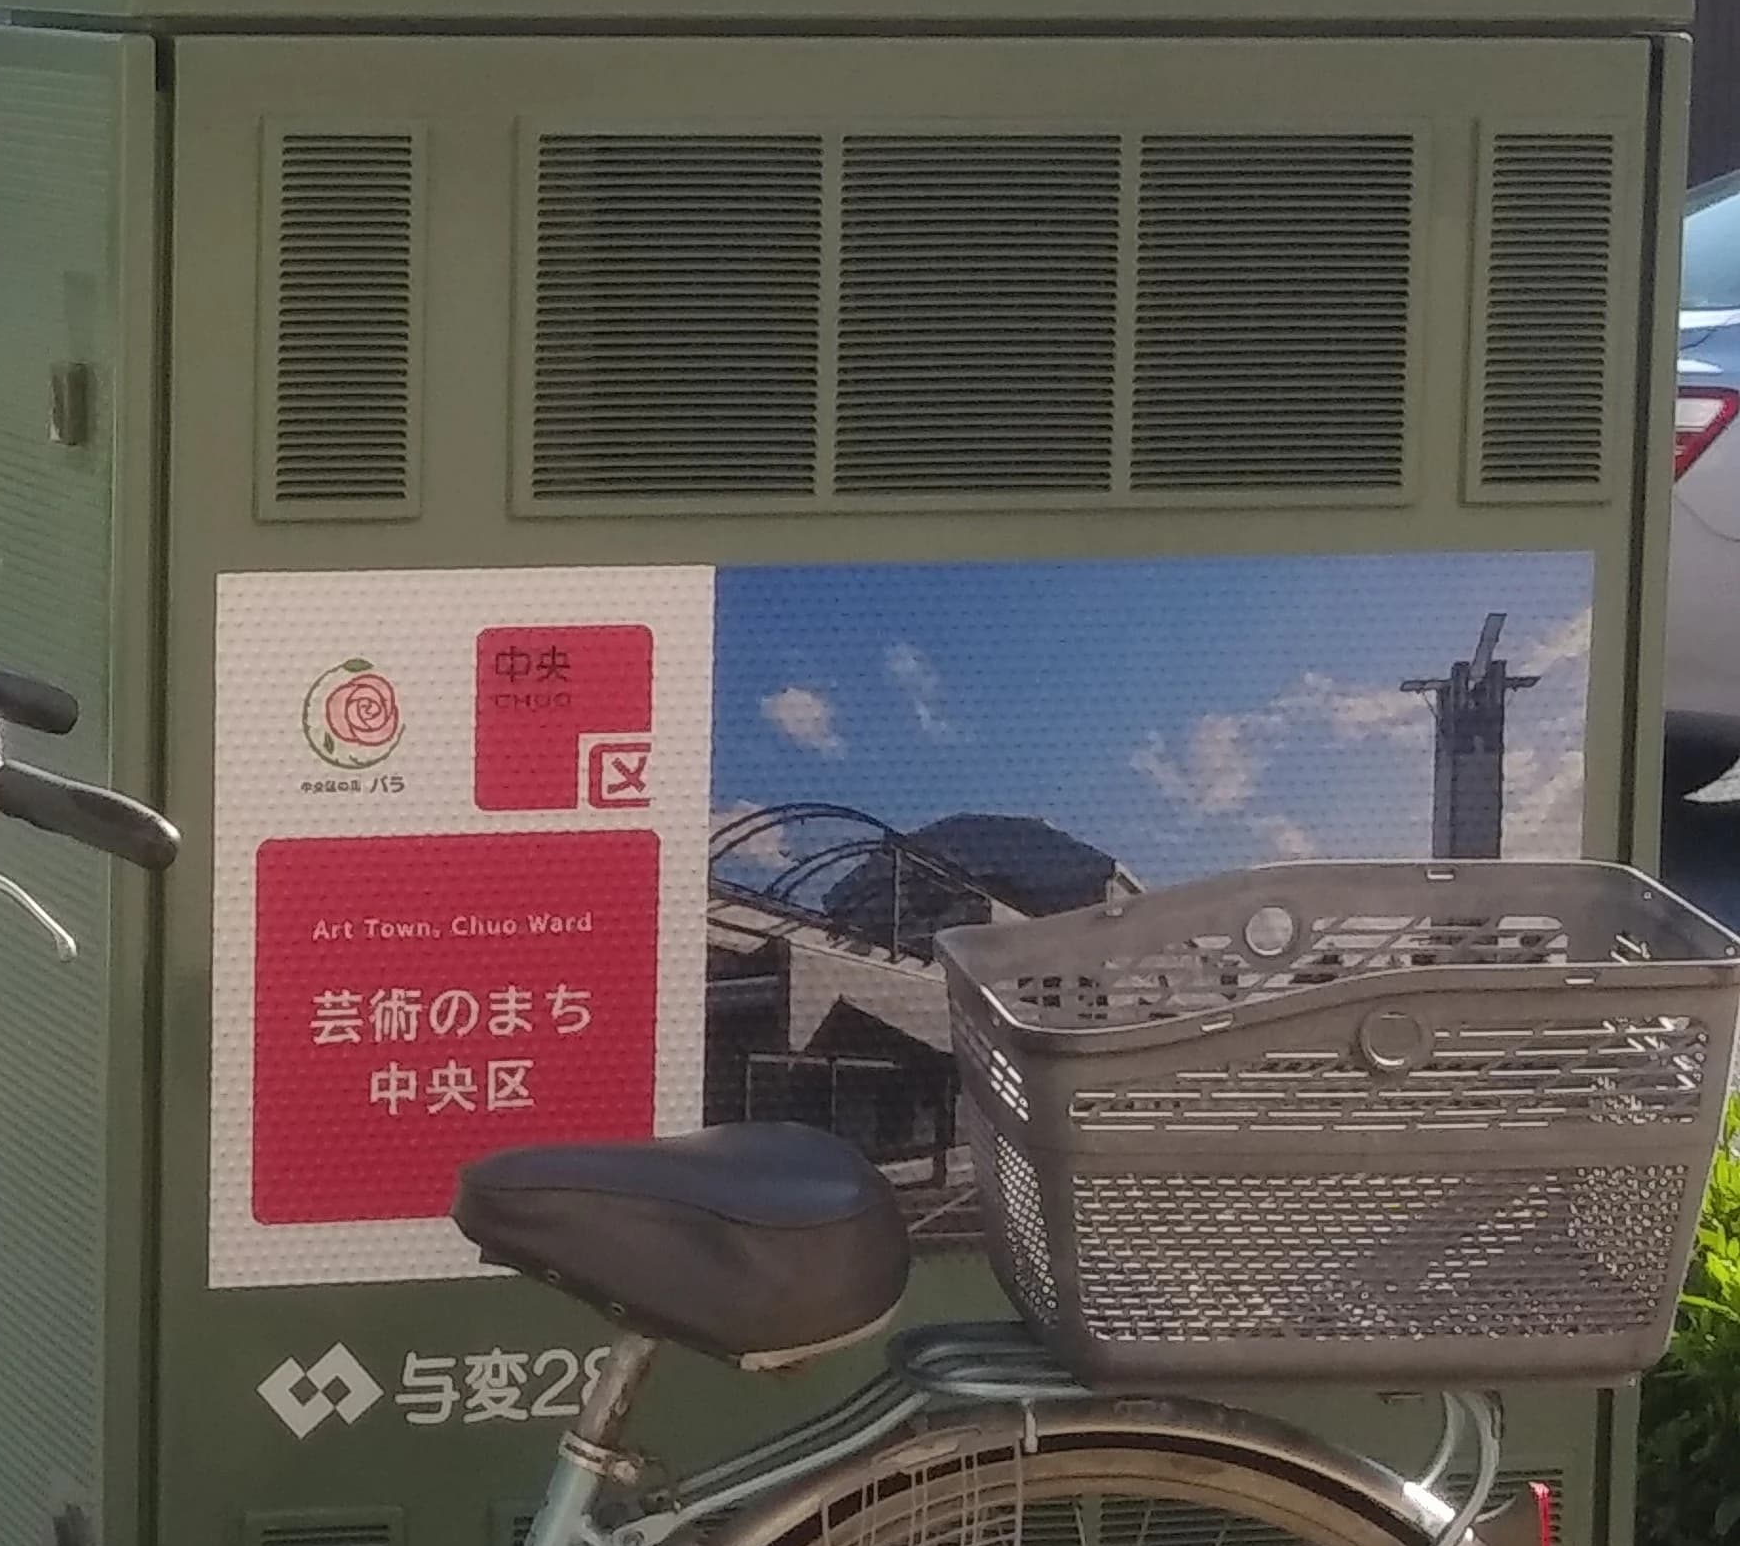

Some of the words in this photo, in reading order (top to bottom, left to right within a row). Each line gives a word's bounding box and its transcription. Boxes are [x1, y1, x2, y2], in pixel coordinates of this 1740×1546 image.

[494, 645, 572, 684] 中央
[312, 919, 353, 940] Art
[364, 918, 441, 938] Town,
[451, 916, 517, 936] Chuo
[527, 911, 593, 933] Ward
[310, 983, 592, 1045] 芸術のまち
[369, 1058, 534, 1115] 中央区
